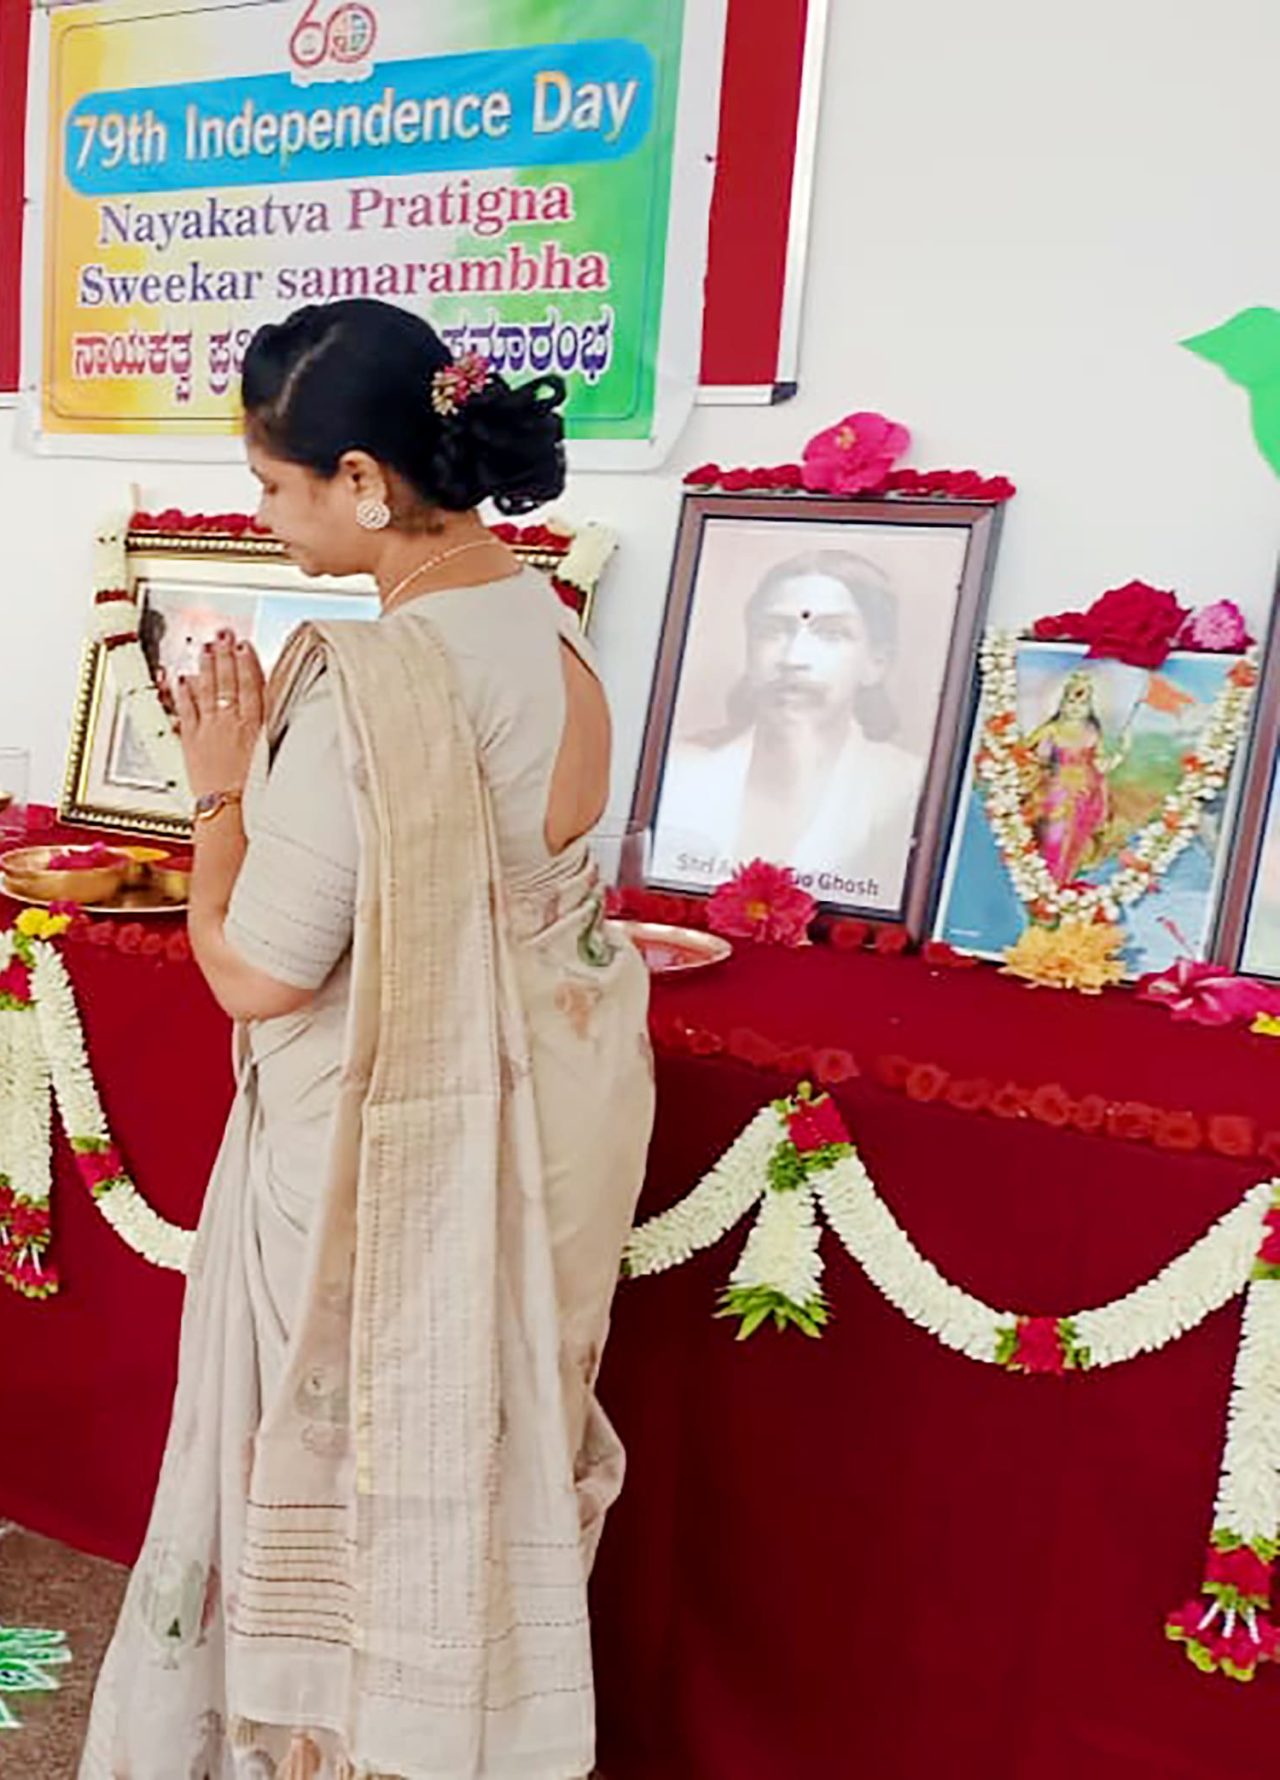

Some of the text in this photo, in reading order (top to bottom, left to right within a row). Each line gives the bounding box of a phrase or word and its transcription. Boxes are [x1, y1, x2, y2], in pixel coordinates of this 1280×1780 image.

[74, 70, 639, 173] 79th Independence Day
[99, 178, 570, 251] Nayakatva Pratigna
[80, 244, 607, 305] Sweekar samarambha
[75, 330, 193, 402] ನಾಯಕತ್ವ
[817, 872, 879, 896] Ghosh
